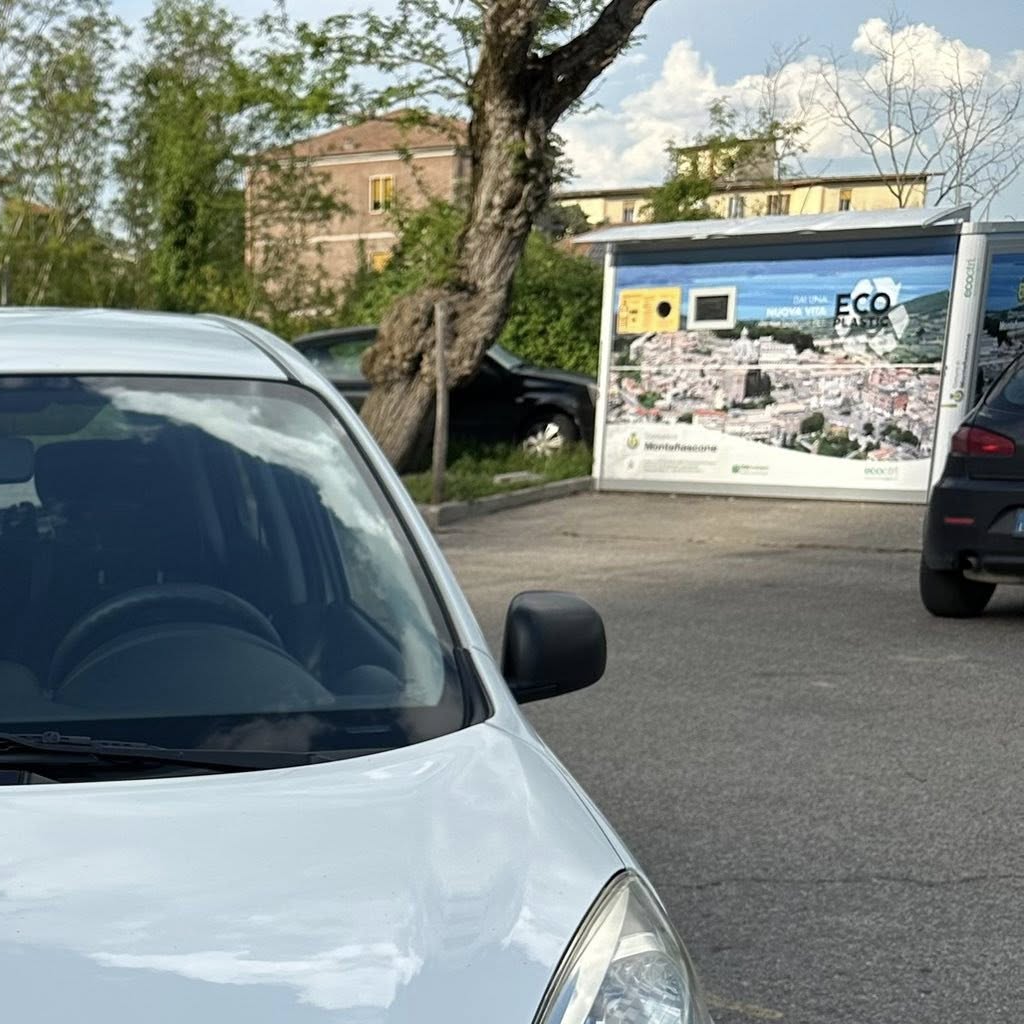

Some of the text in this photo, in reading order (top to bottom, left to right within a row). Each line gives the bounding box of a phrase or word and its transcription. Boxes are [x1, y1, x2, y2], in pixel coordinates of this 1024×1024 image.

[836, 292, 891, 315] ECO
[766, 306, 827, 318] NUOVA VITA
[833, 317, 890, 329] PLASTIC
[644, 442, 718, 453] Montefiascone
